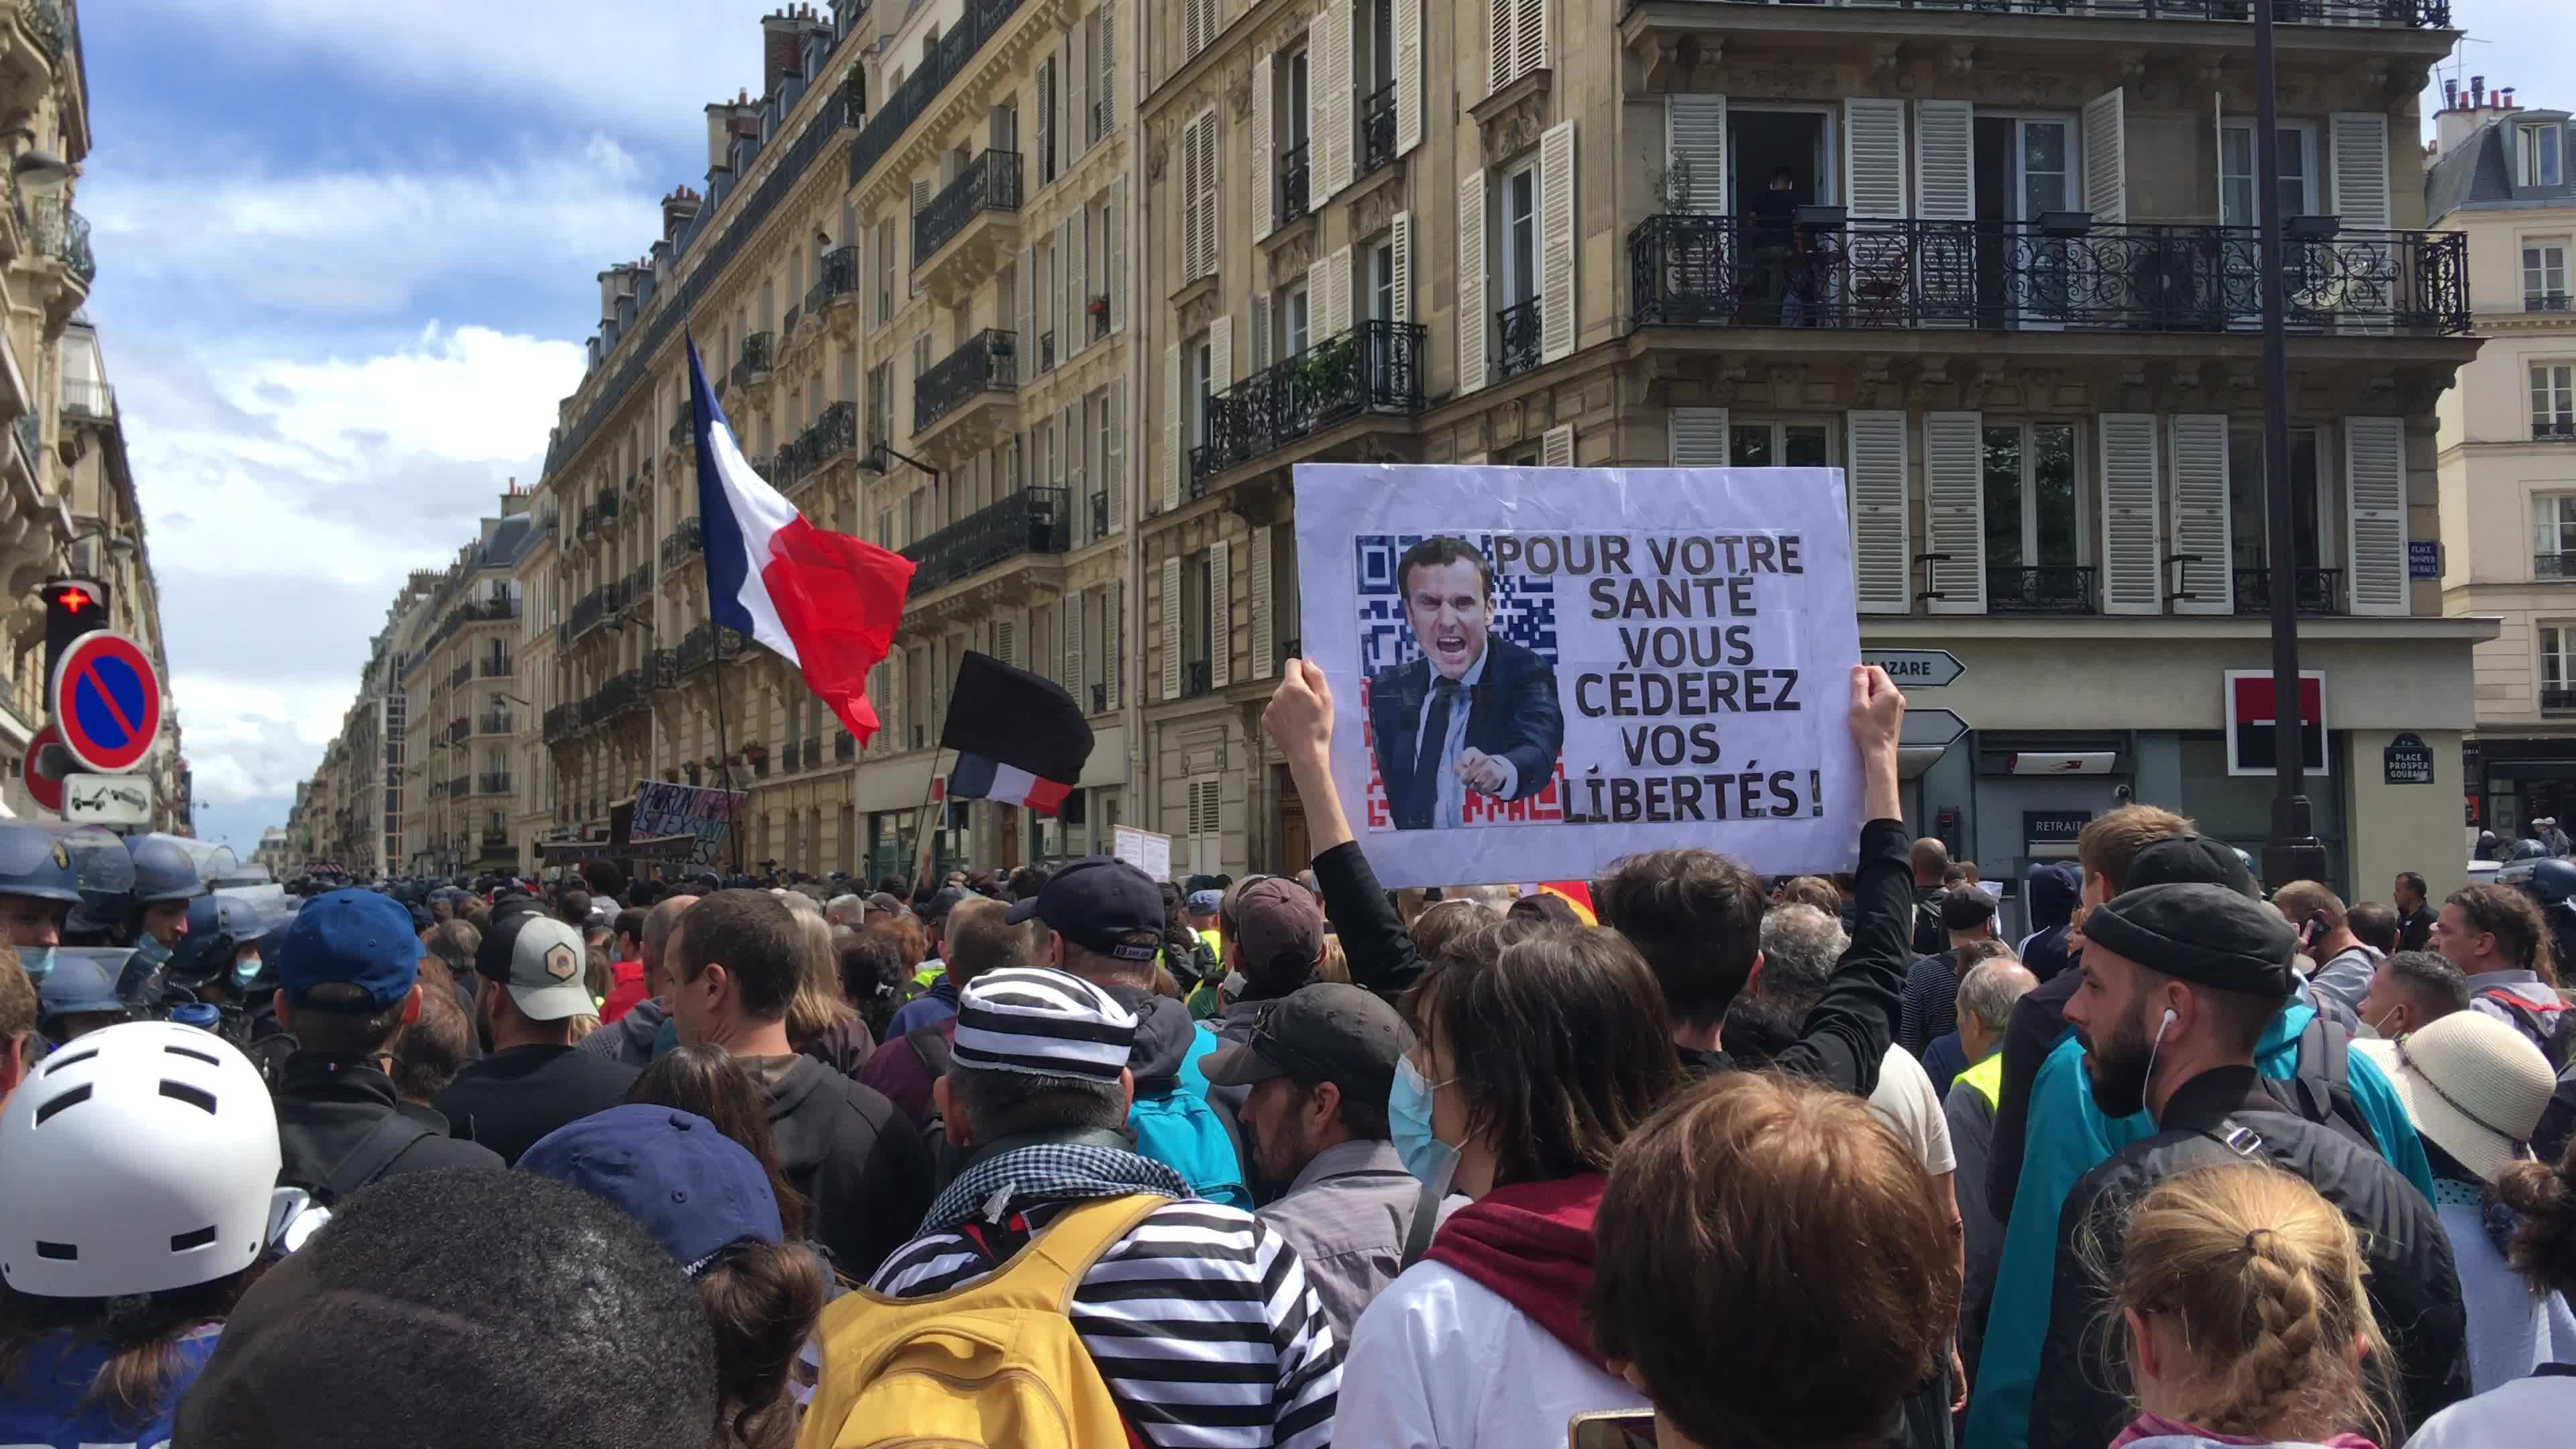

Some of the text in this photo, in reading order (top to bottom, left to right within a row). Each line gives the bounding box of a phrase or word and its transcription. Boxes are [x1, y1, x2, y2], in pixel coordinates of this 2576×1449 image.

[1494, 536, 1803, 576] POUR VOTRE
[1589, 569, 1757, 620] SANTÉ
[1618, 625, 1754, 667] VOUS
[1576, 662, 1801, 716] CÉDEREZ
[1870, 661, 1931, 676] AZARE
[1621, 723, 1720, 766] VOS
[2395, 753, 2422, 761] PLACE
[2036, 821, 2082, 832] RETRAIT
